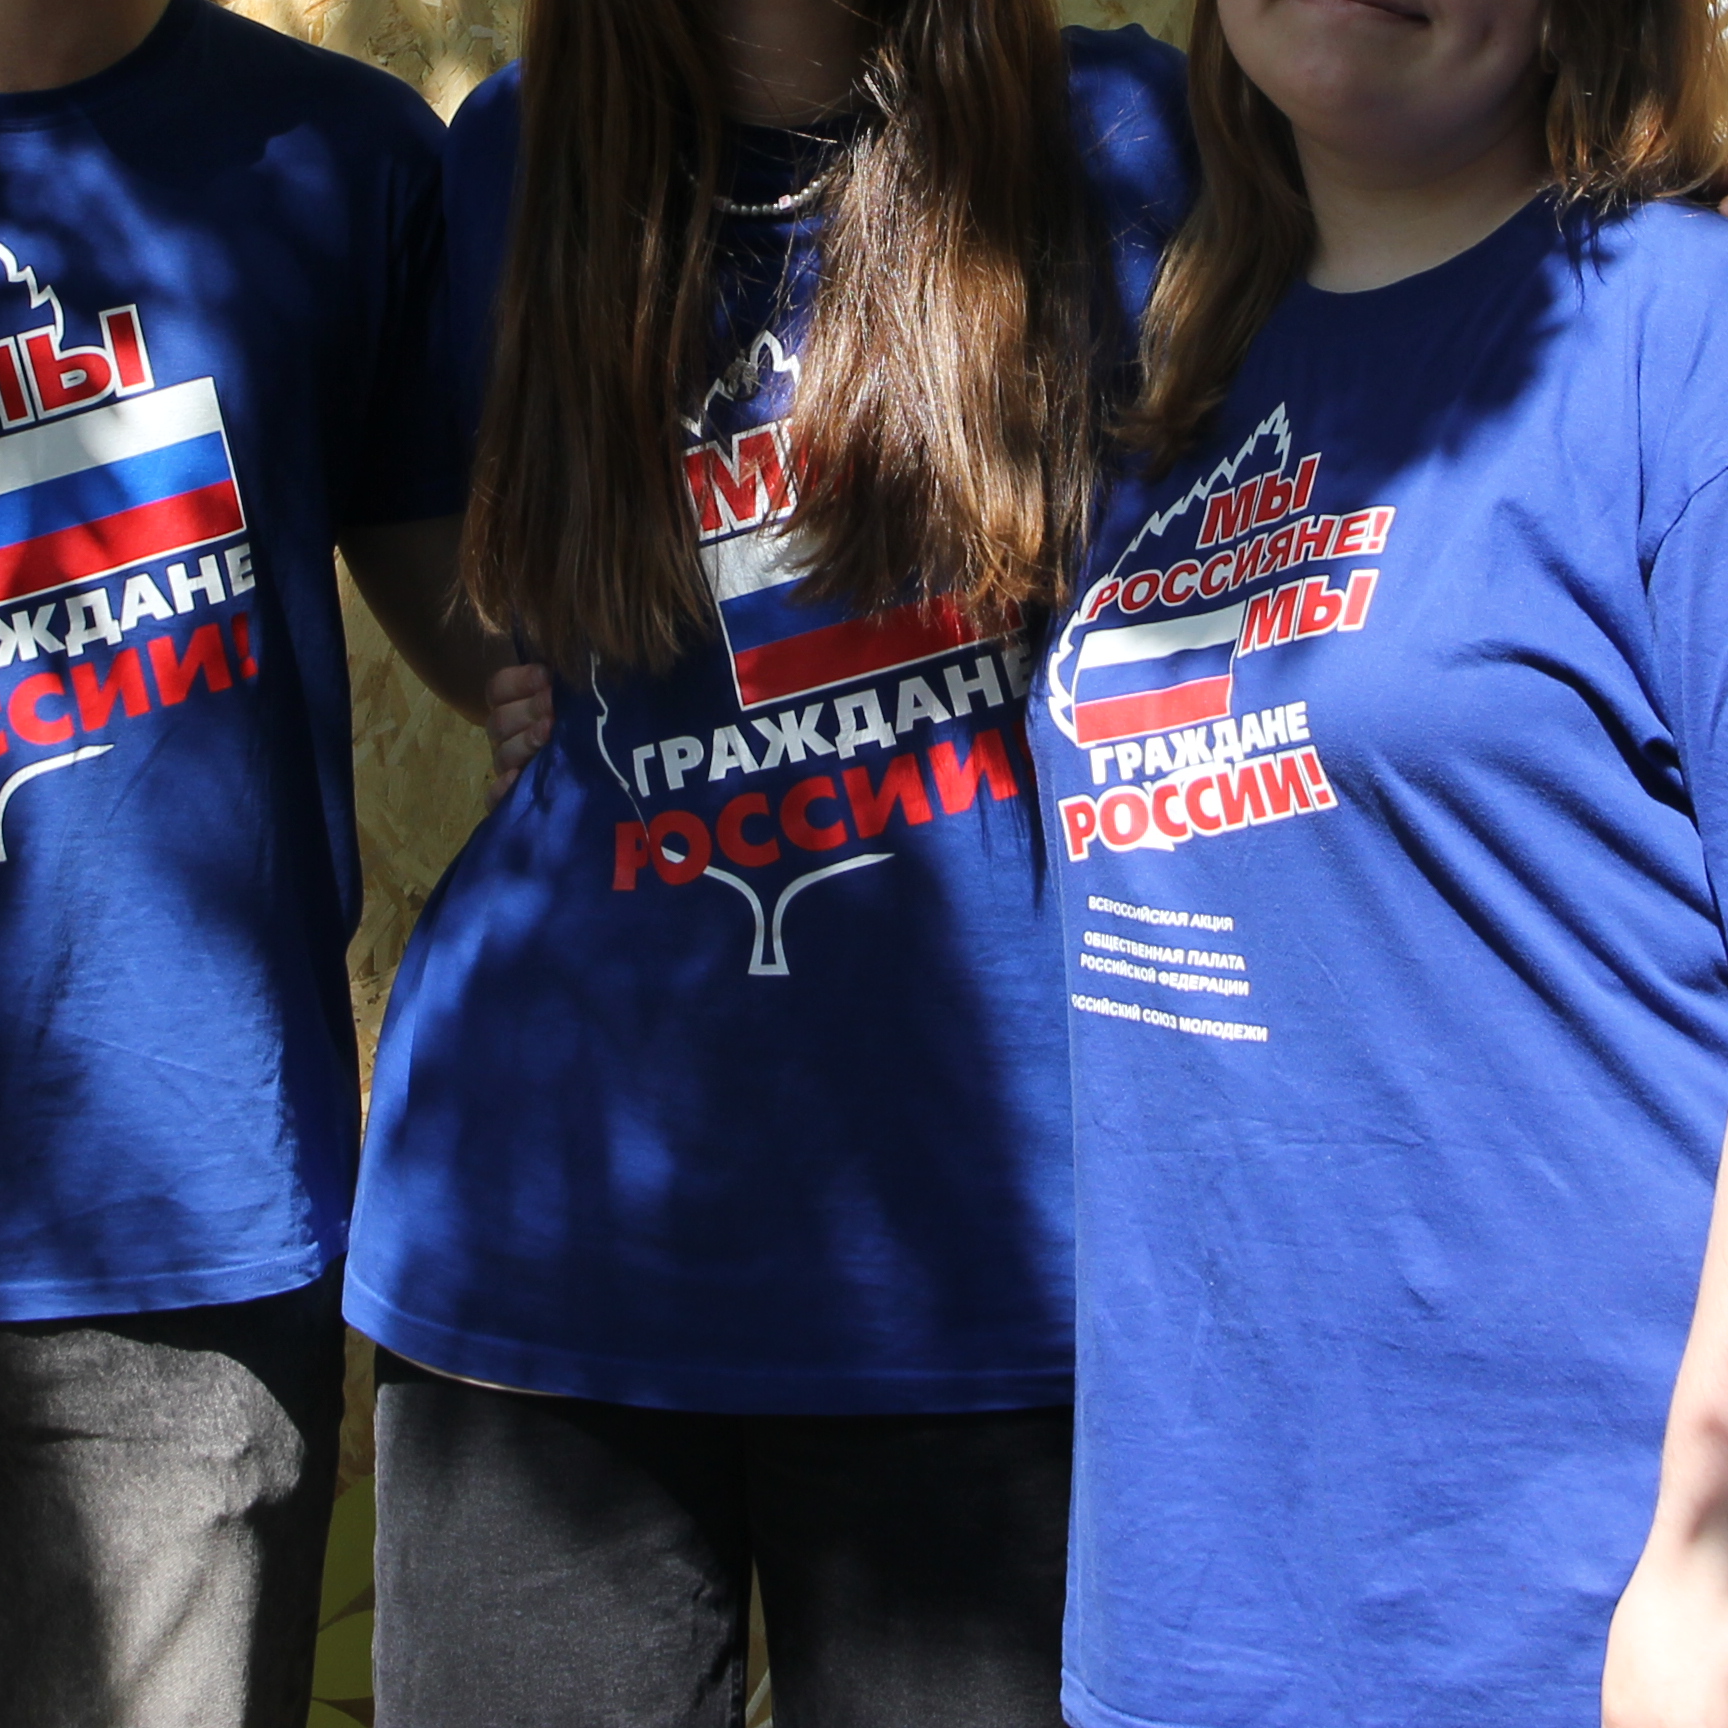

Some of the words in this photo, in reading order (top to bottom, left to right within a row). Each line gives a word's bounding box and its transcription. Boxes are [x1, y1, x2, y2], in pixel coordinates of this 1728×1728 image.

[1196, 452, 1321, 549] МЫ
[1084, 506, 1396, 621] РОССИЯНЕ!
[1237, 569, 1379, 658] МЫ
[1089, 701, 1310, 784] ГРАЖДАНЕ
[1058, 745, 1339, 861] РОССИИ!
[1083, 931, 1185, 963] ОБЩЕСТВЕННАЯ
[1187, 950, 1246, 971] ПАЛАТА
[1190, 914, 1234, 931] АКЦИЯ
[1080, 953, 1156, 983] РОССИЙСКОЙ
[1158, 971, 1250, 997] ФЕДЕРАЦИИ
[1142, 1008, 1177, 1029] СОЮЗ
[1178, 1016, 1269, 1042] МОЛОДЕЖИ
